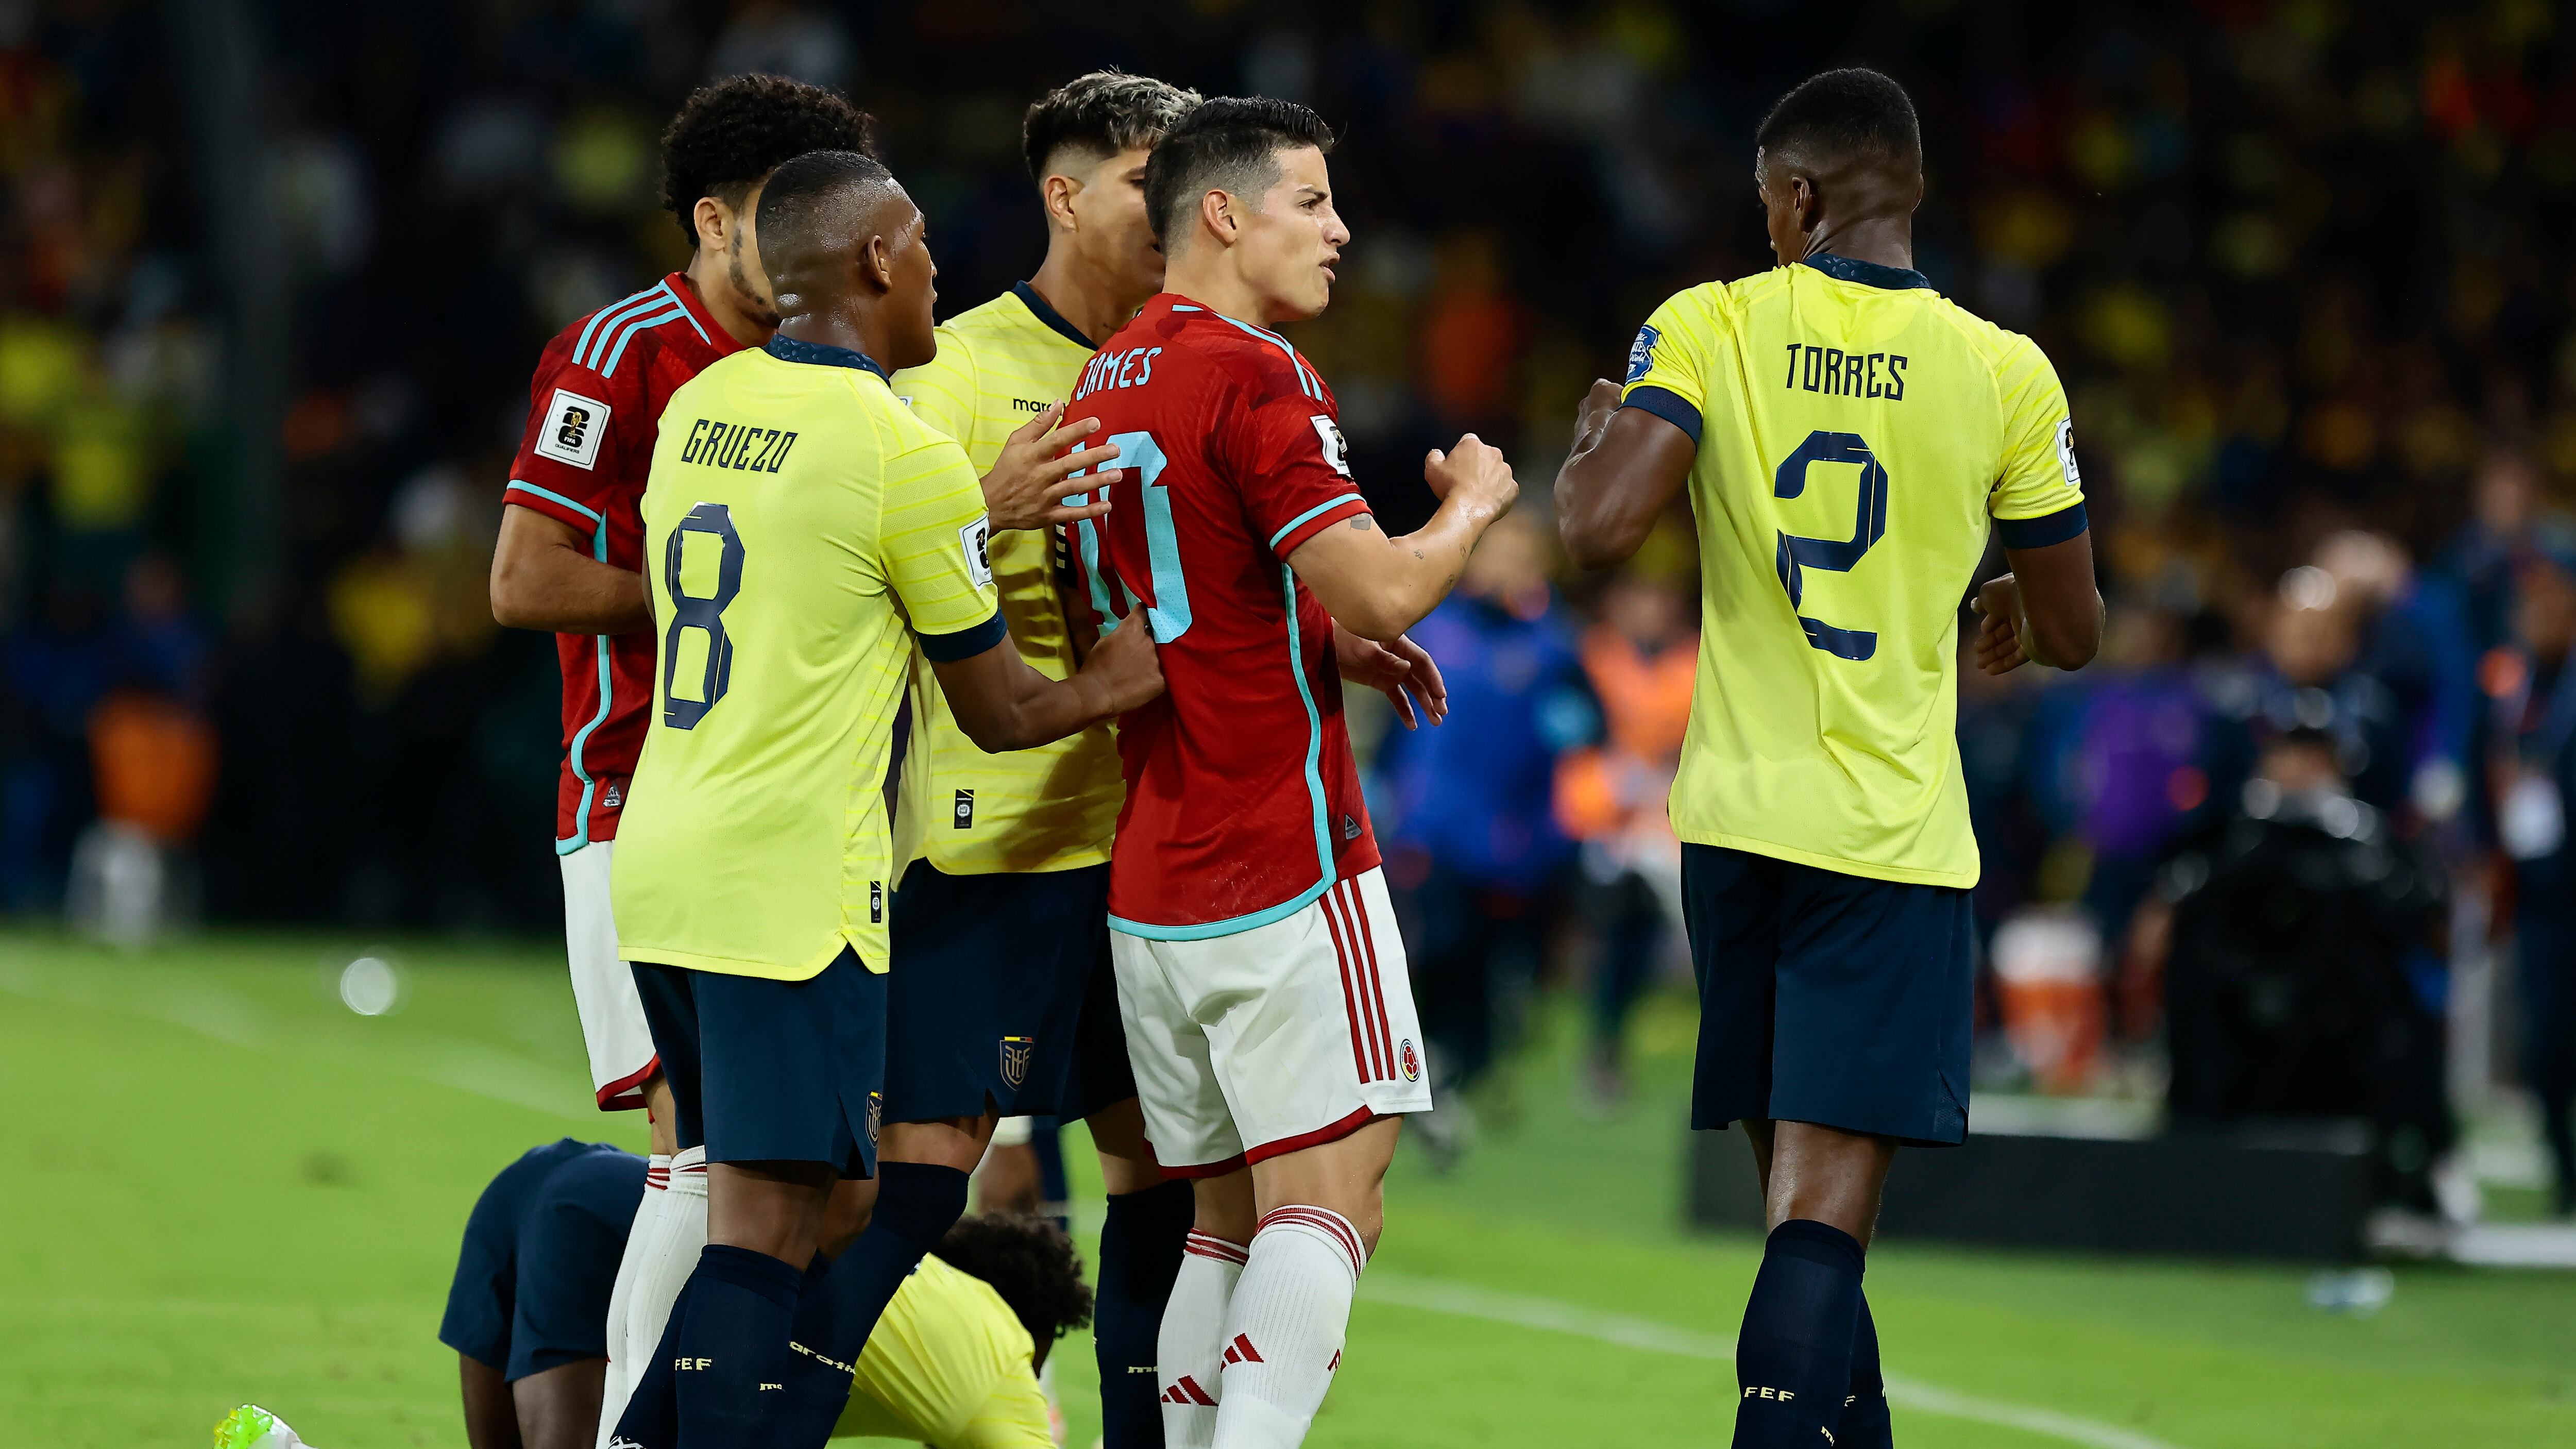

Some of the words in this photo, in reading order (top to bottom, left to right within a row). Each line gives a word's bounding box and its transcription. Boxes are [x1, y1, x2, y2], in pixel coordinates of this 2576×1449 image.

[1076, 347, 1162, 401] JAMES
[1786, 343, 1908, 401] TORRES
[1013, 398, 1053, 413] mar
[681, 419, 798, 473] GRUEZO
[1774, 430, 1888, 661] 2
[664, 501, 745, 731] 8
[675, 1358, 712, 1371] FEF
[1744, 1387, 1795, 1402] FEF
